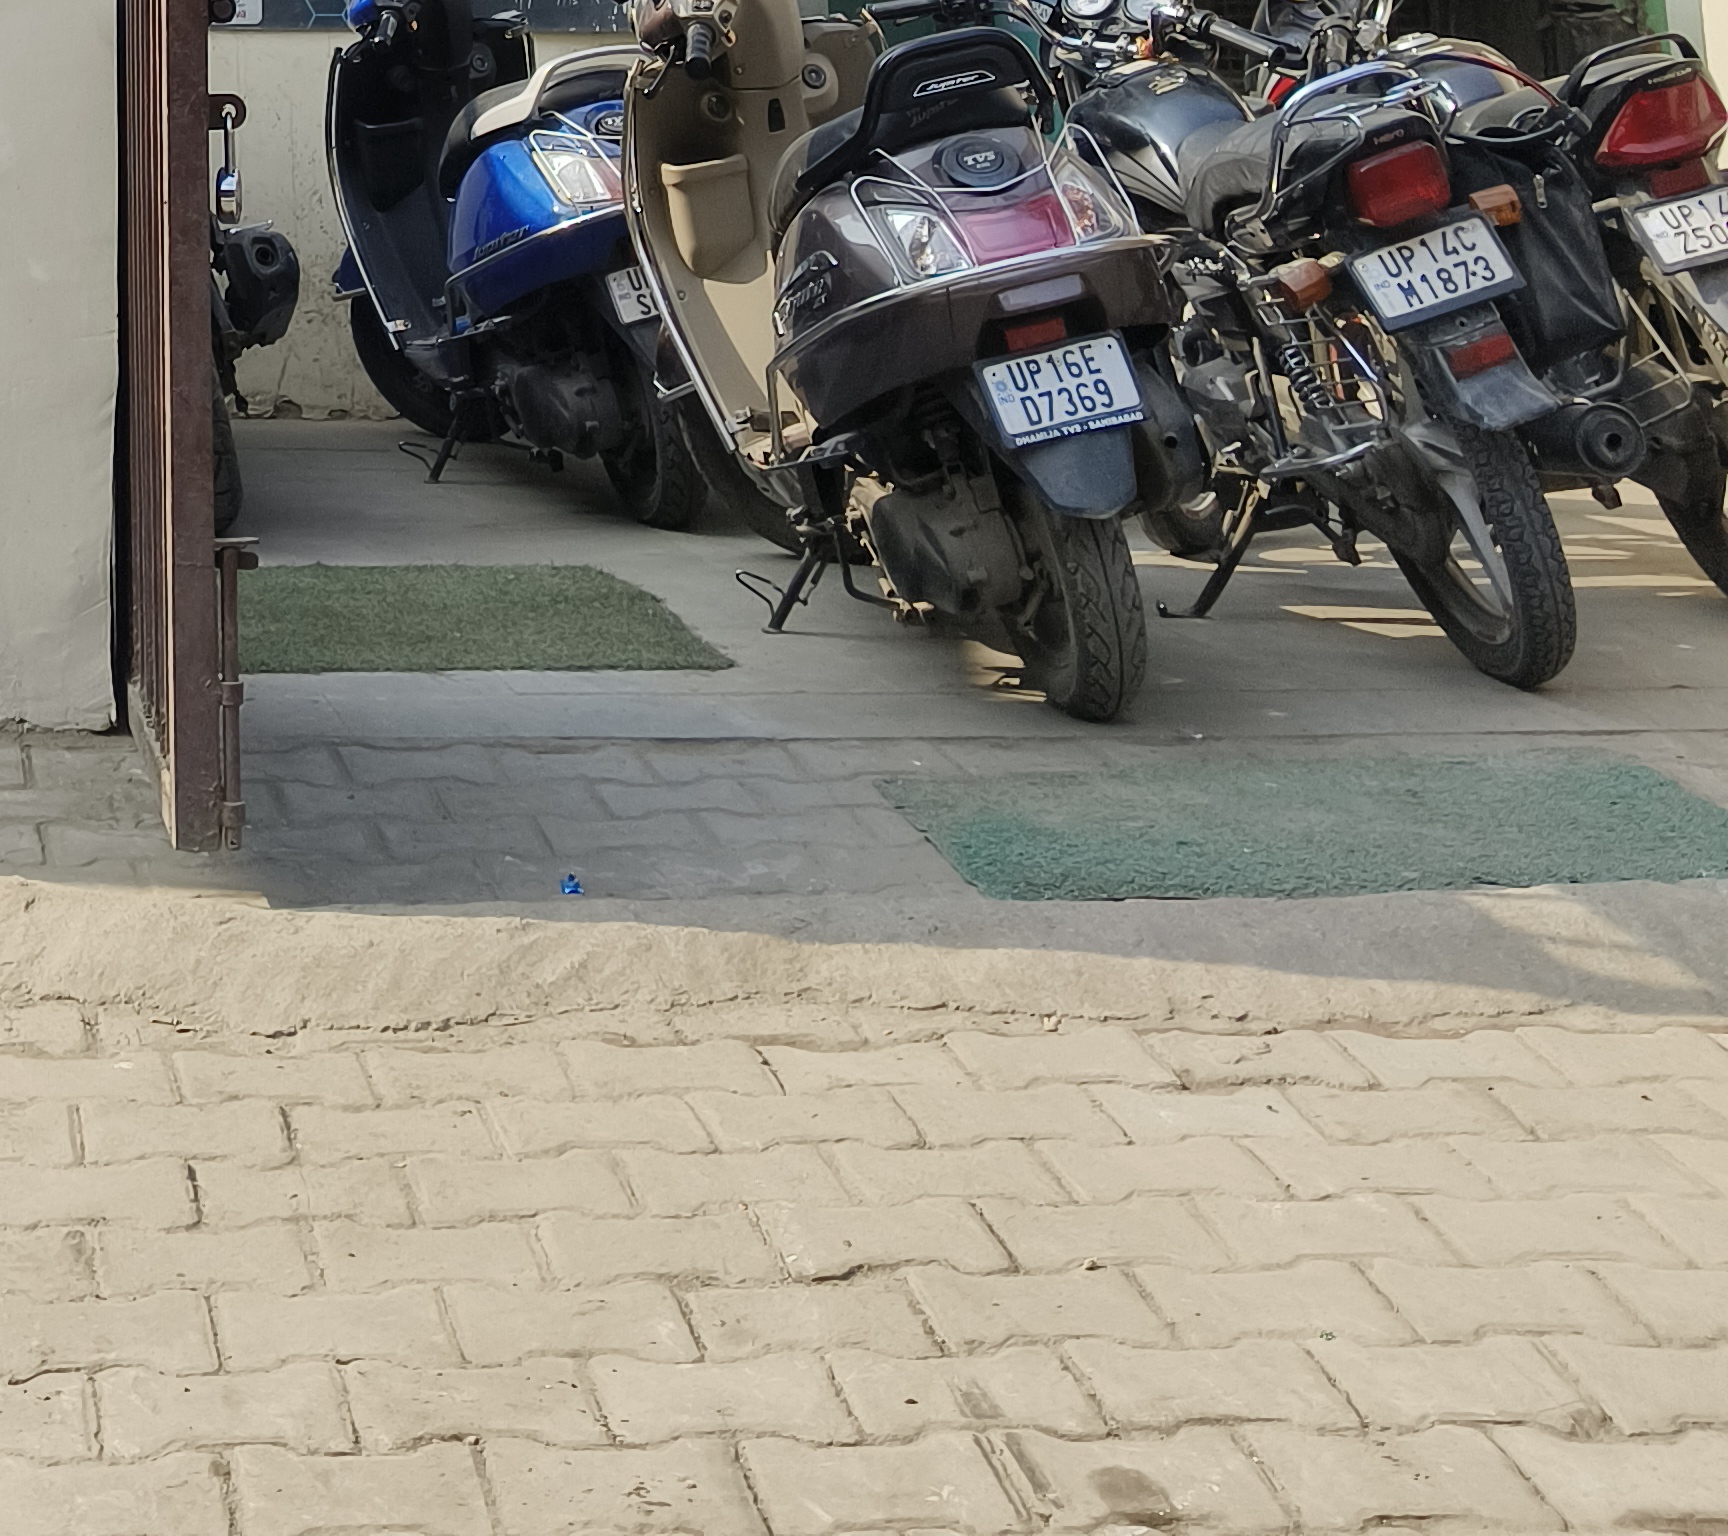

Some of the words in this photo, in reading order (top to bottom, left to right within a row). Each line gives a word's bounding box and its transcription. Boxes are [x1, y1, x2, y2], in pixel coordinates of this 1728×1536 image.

[626, 268, 649, 292] U
[1397, 255, 1496, 308] M1873
[636, 293, 659, 316] S
[1020, 378, 1114, 426] D7369
